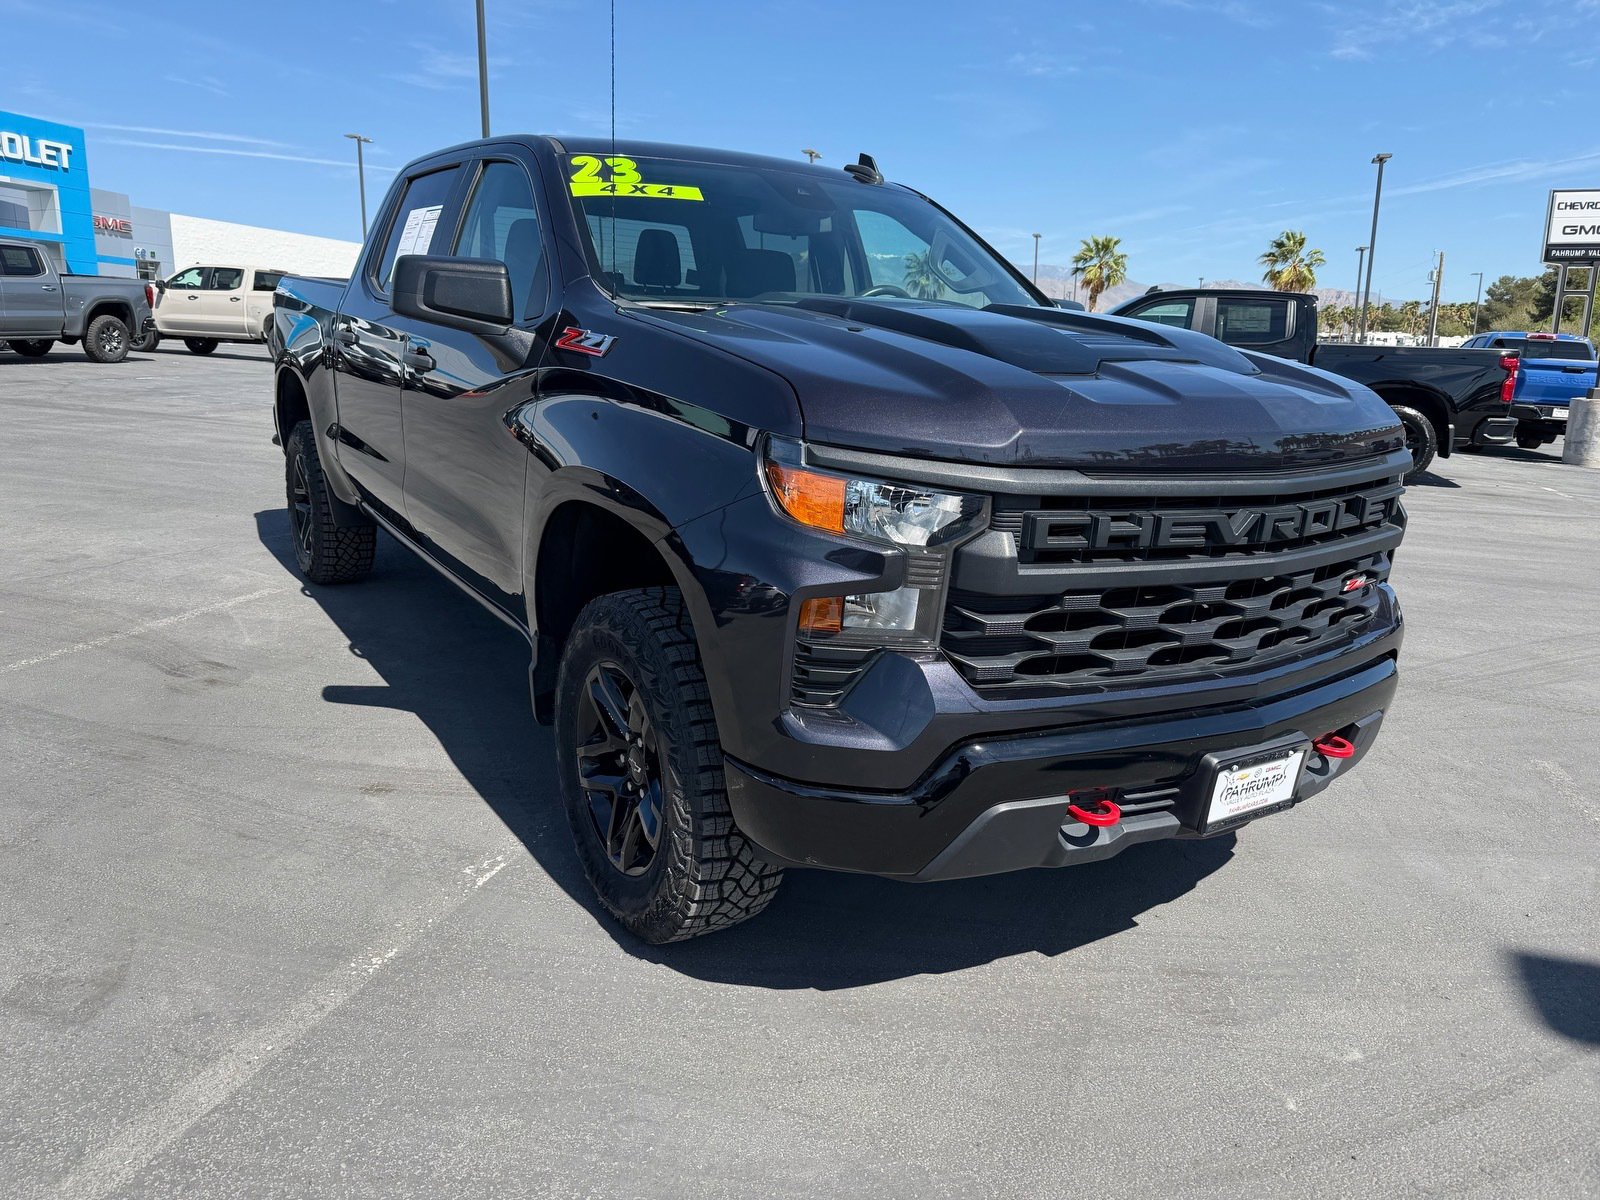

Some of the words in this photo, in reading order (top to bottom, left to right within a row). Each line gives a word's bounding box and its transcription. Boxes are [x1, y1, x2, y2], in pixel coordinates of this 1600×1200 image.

[0, 131, 73, 169] OLET
[570, 155, 642, 184] 23
[1562, 224, 1600, 236] GM
[1551, 248, 1586, 257] PAHRUMP
[555, 326, 619, 358] Z71
[1020, 487, 1406, 551] CHEVROLET
[1224, 773, 1285, 801] PAHRUMP
